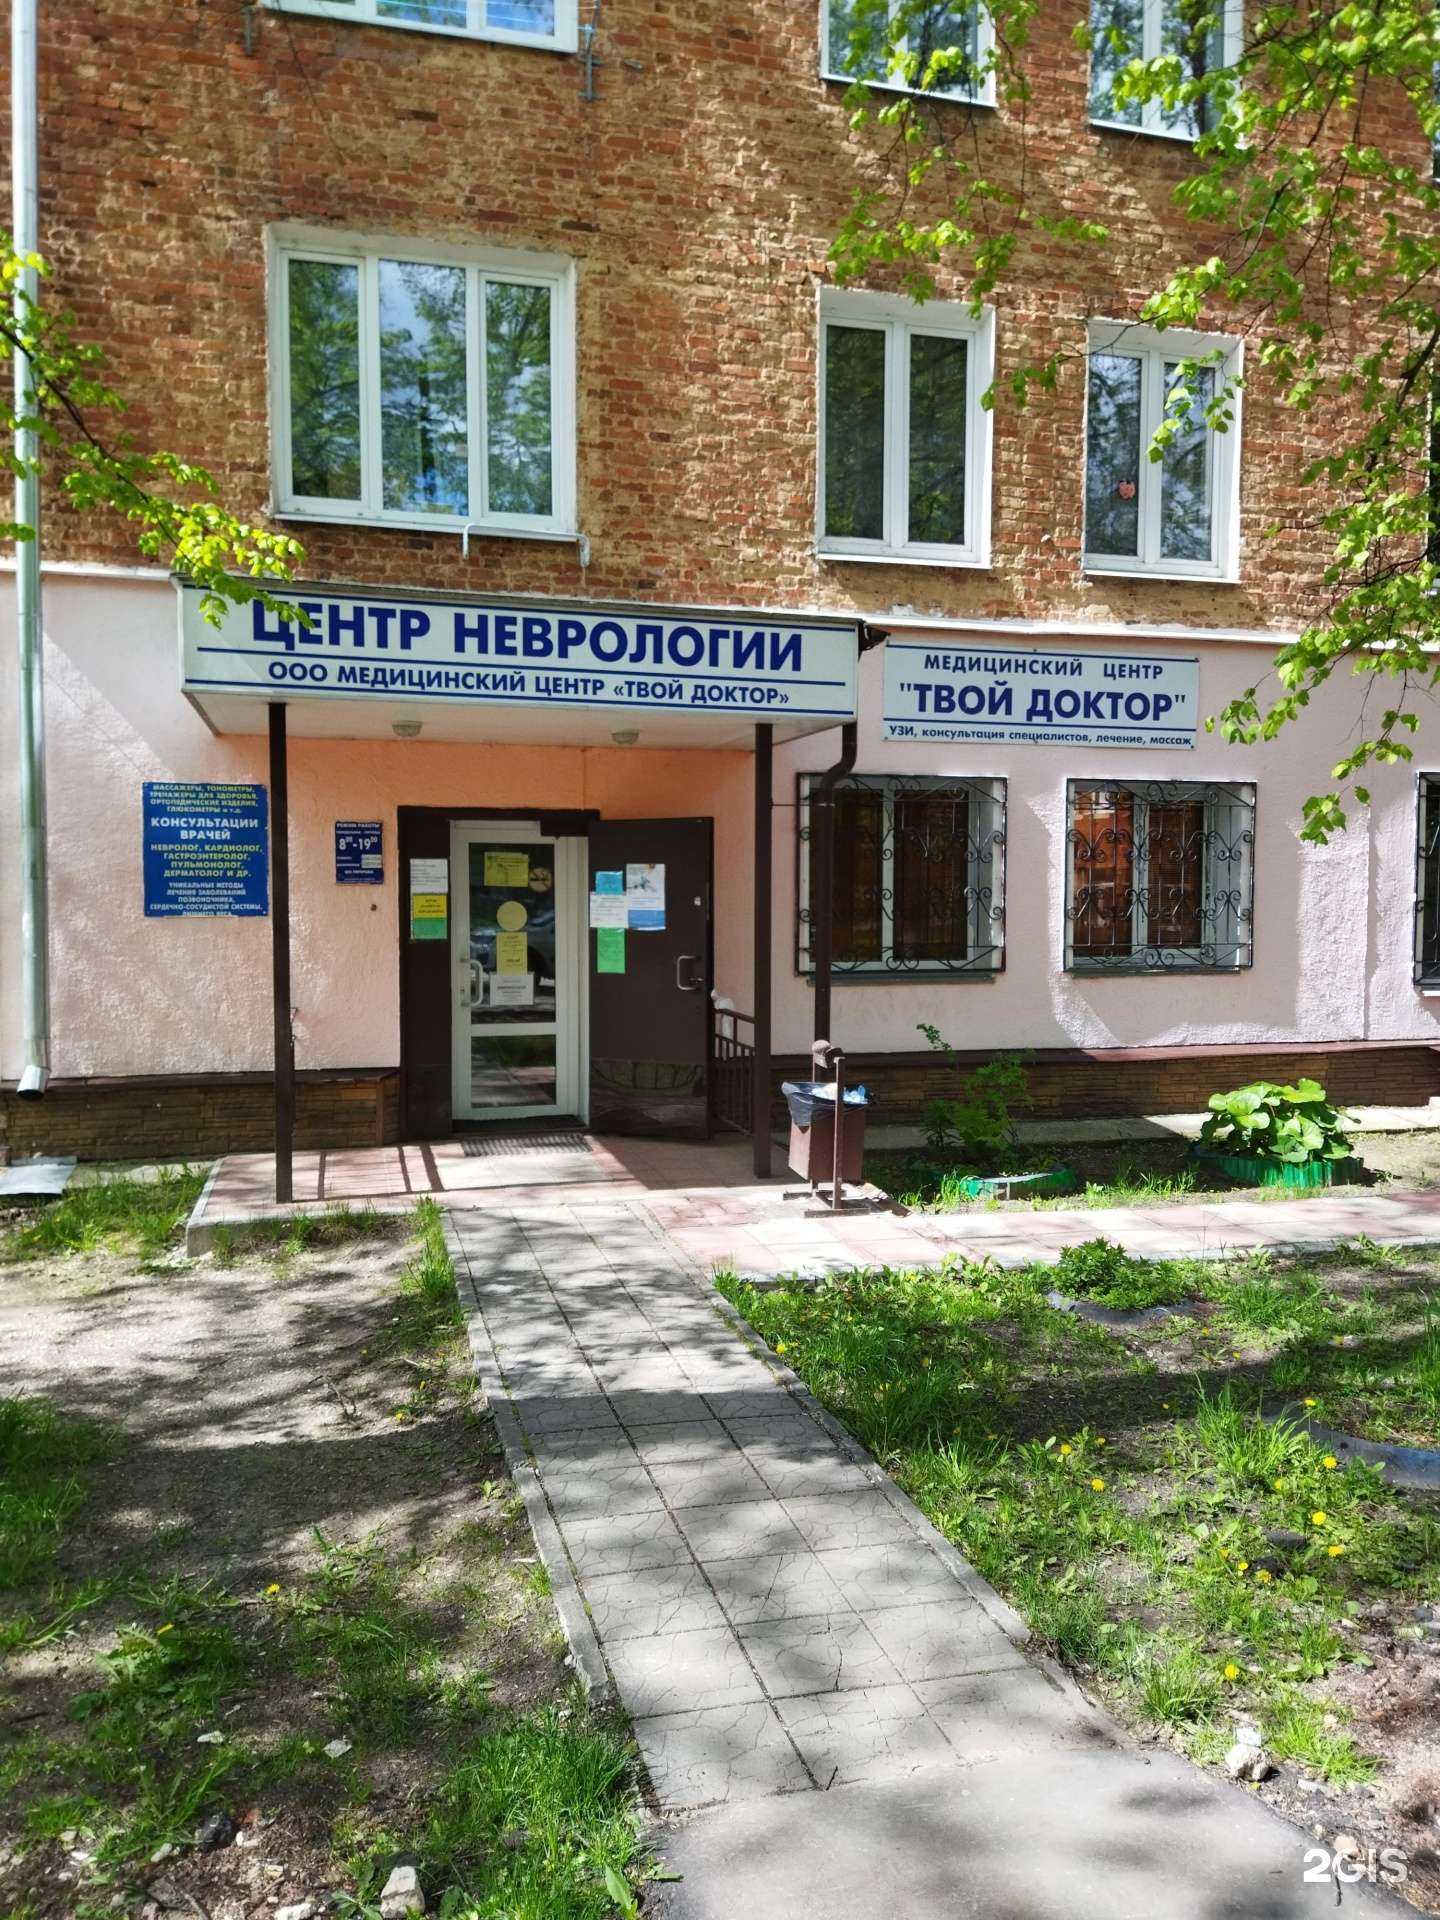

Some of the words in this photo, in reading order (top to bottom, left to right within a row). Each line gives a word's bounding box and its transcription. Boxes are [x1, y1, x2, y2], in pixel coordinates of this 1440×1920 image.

[253, 600, 431, 651] ЦЕНТР
[454, 612, 802, 672] НЕВРОЛОГИИ
[924, 654, 1083, 677] МЕДИЦИНСКИЙ
[1103, 663, 1163, 680] ЦЕНТР
[268, 661, 328, 682] ООО
[337, 665, 525, 692] МЕДИЦИНСКИЙ
[535, 676, 605, 697] ЦЕНТР
[613, 680, 683, 701] «ТВОЙ
[691, 684, 789, 704] ДОКТОР»
[899, 680, 1013, 716] "ТВОЙ
[1026, 688, 1186, 722] ДОКТОР"
[889, 725, 918, 738] УЗИ,
[922, 728, 1005, 740] консультация
[1009, 730, 1092, 743] специалистов,
[1096, 734, 1146, 745] лечение,
[1150, 735, 1192, 746] массаж
[151, 817, 259, 829] КОНСУЛЬТАЦИИ
[180, 829, 231, 840] ВРАЧЕЙ
[151, 844, 201, 852] НЕВРОЛОГ,
[204, 844, 262, 852] КАРДИОЛОГ,
[163, 853, 251, 861] ГАСТРОЭНТЕРОЛОГ,
[171, 861, 244, 869] ПУЛЬМОНОЛОГ,
[236, 870, 251, 878] ДР.
